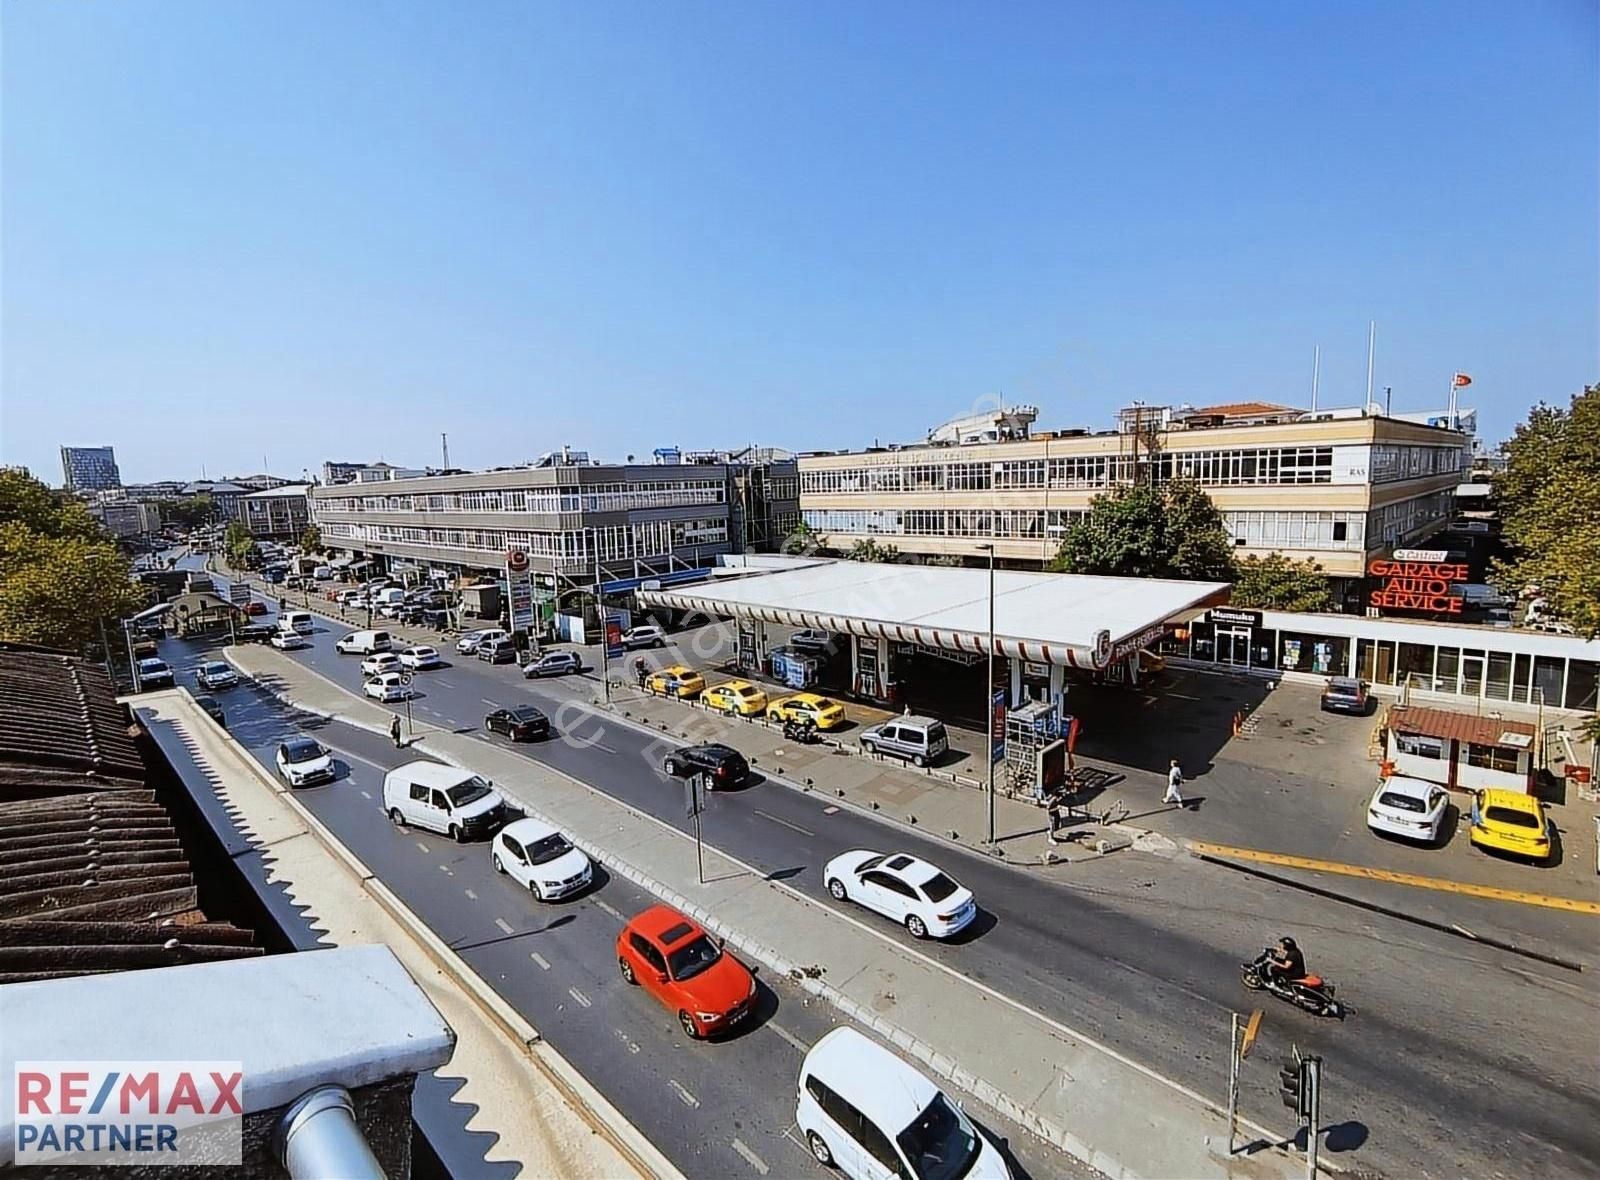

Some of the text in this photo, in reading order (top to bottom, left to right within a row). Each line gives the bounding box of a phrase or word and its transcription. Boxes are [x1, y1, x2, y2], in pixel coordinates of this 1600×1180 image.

[1369, 560, 1469, 581] GARAGE
[1384, 577, 1448, 594] AUTO
[1370, 592, 1464, 613] SERVICE
